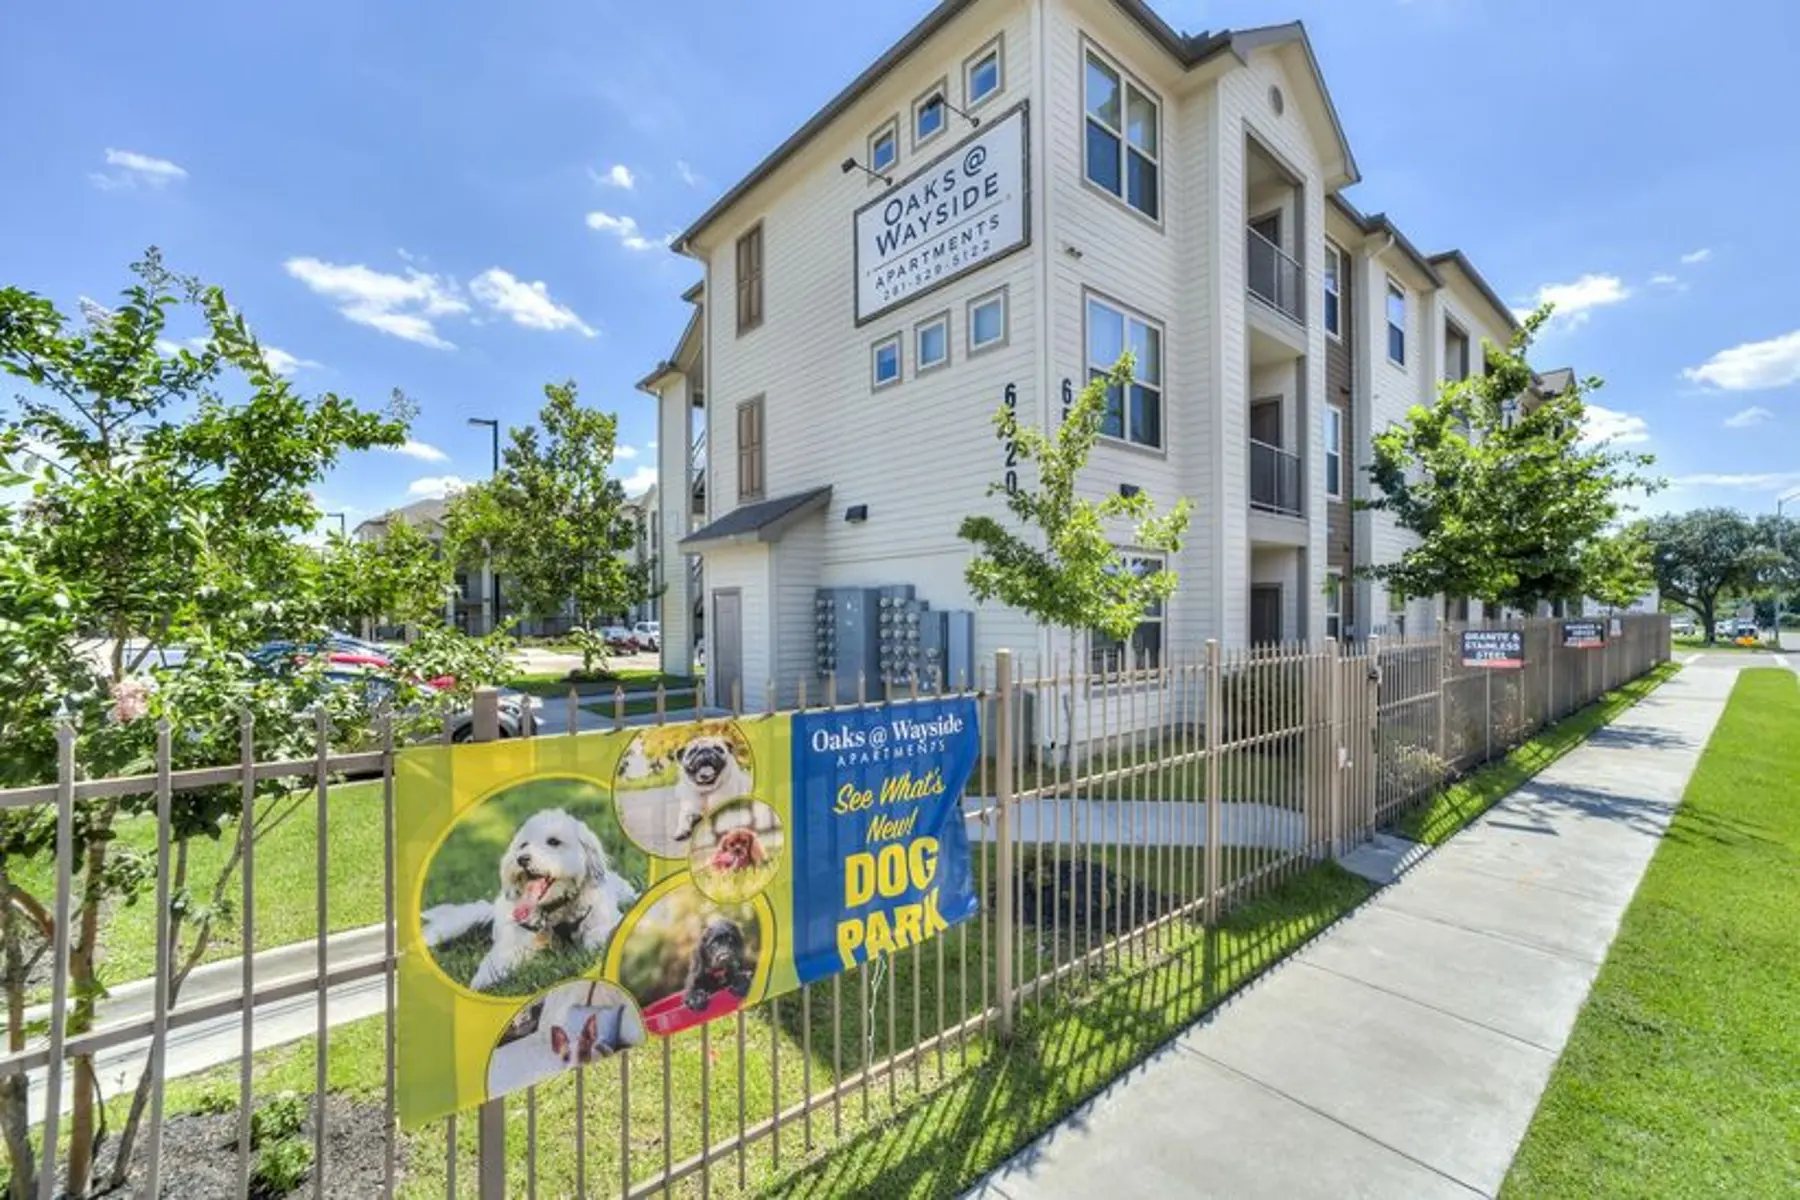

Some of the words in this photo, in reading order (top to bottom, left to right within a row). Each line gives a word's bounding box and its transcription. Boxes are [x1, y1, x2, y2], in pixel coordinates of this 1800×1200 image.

[875, 172, 999, 257] WAYSIDE
[884, 168, 957, 227] OAKS
[963, 145, 987, 177] @
[875, 214, 1000, 290] APARTMENTS
[812, 728, 866, 753] Oaks
[868, 727, 888, 748] @
[893, 714, 963, 743] Wayside
[836, 739, 946, 767] APARTMENTS
[832, 782, 874, 815] See
[879, 768, 947, 805] What's
[866, 808, 918, 844] New!
[845, 836, 939, 908] DOG
[837, 887, 949, 970] PARK
